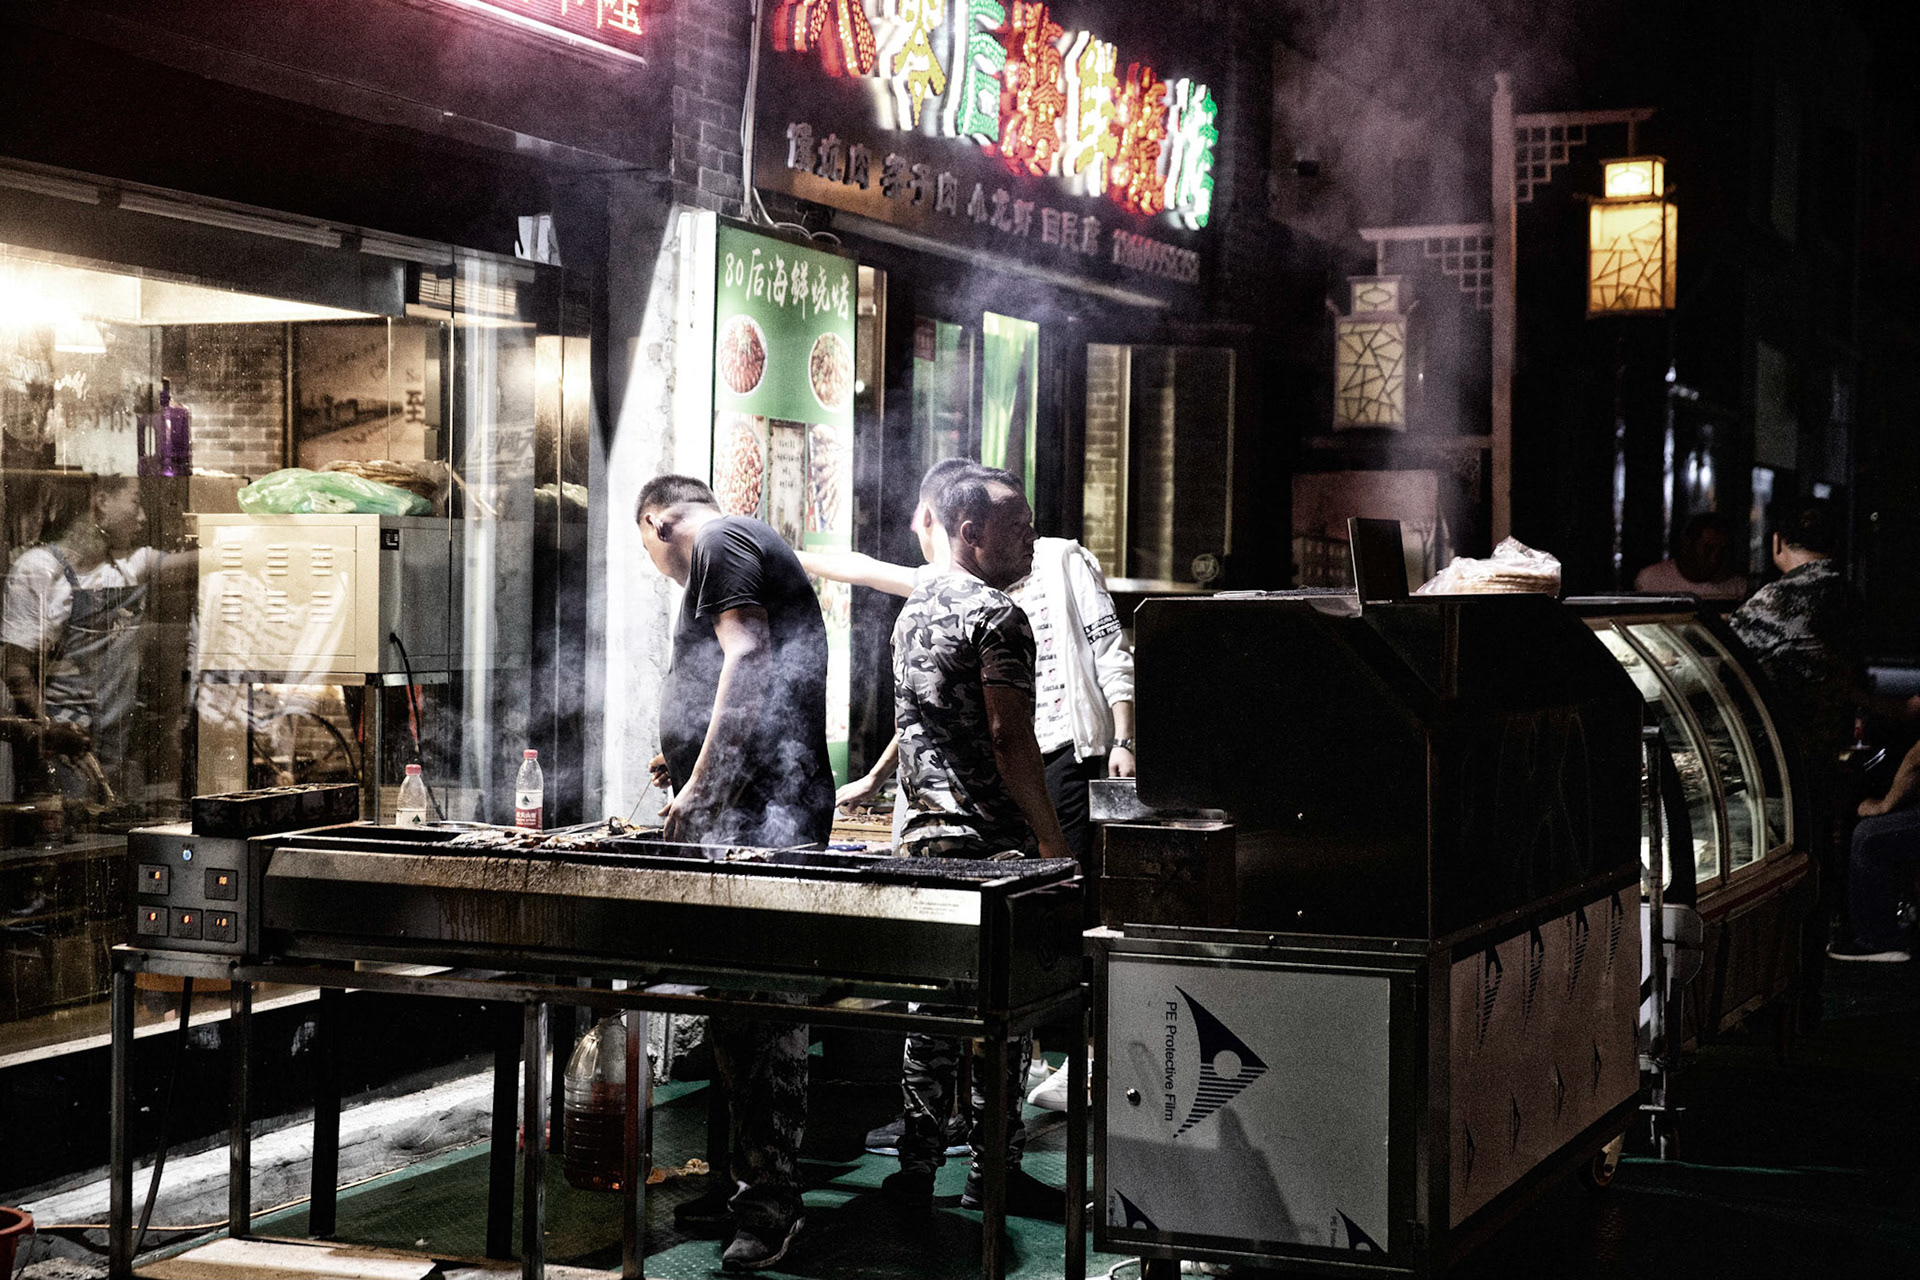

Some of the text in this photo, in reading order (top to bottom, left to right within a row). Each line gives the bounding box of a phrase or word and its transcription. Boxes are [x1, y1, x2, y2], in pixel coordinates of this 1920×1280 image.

[725, 248, 849, 321] 80后海鲜烧烤
[1164, 1001, 1178, 1121] PE Protective Film
